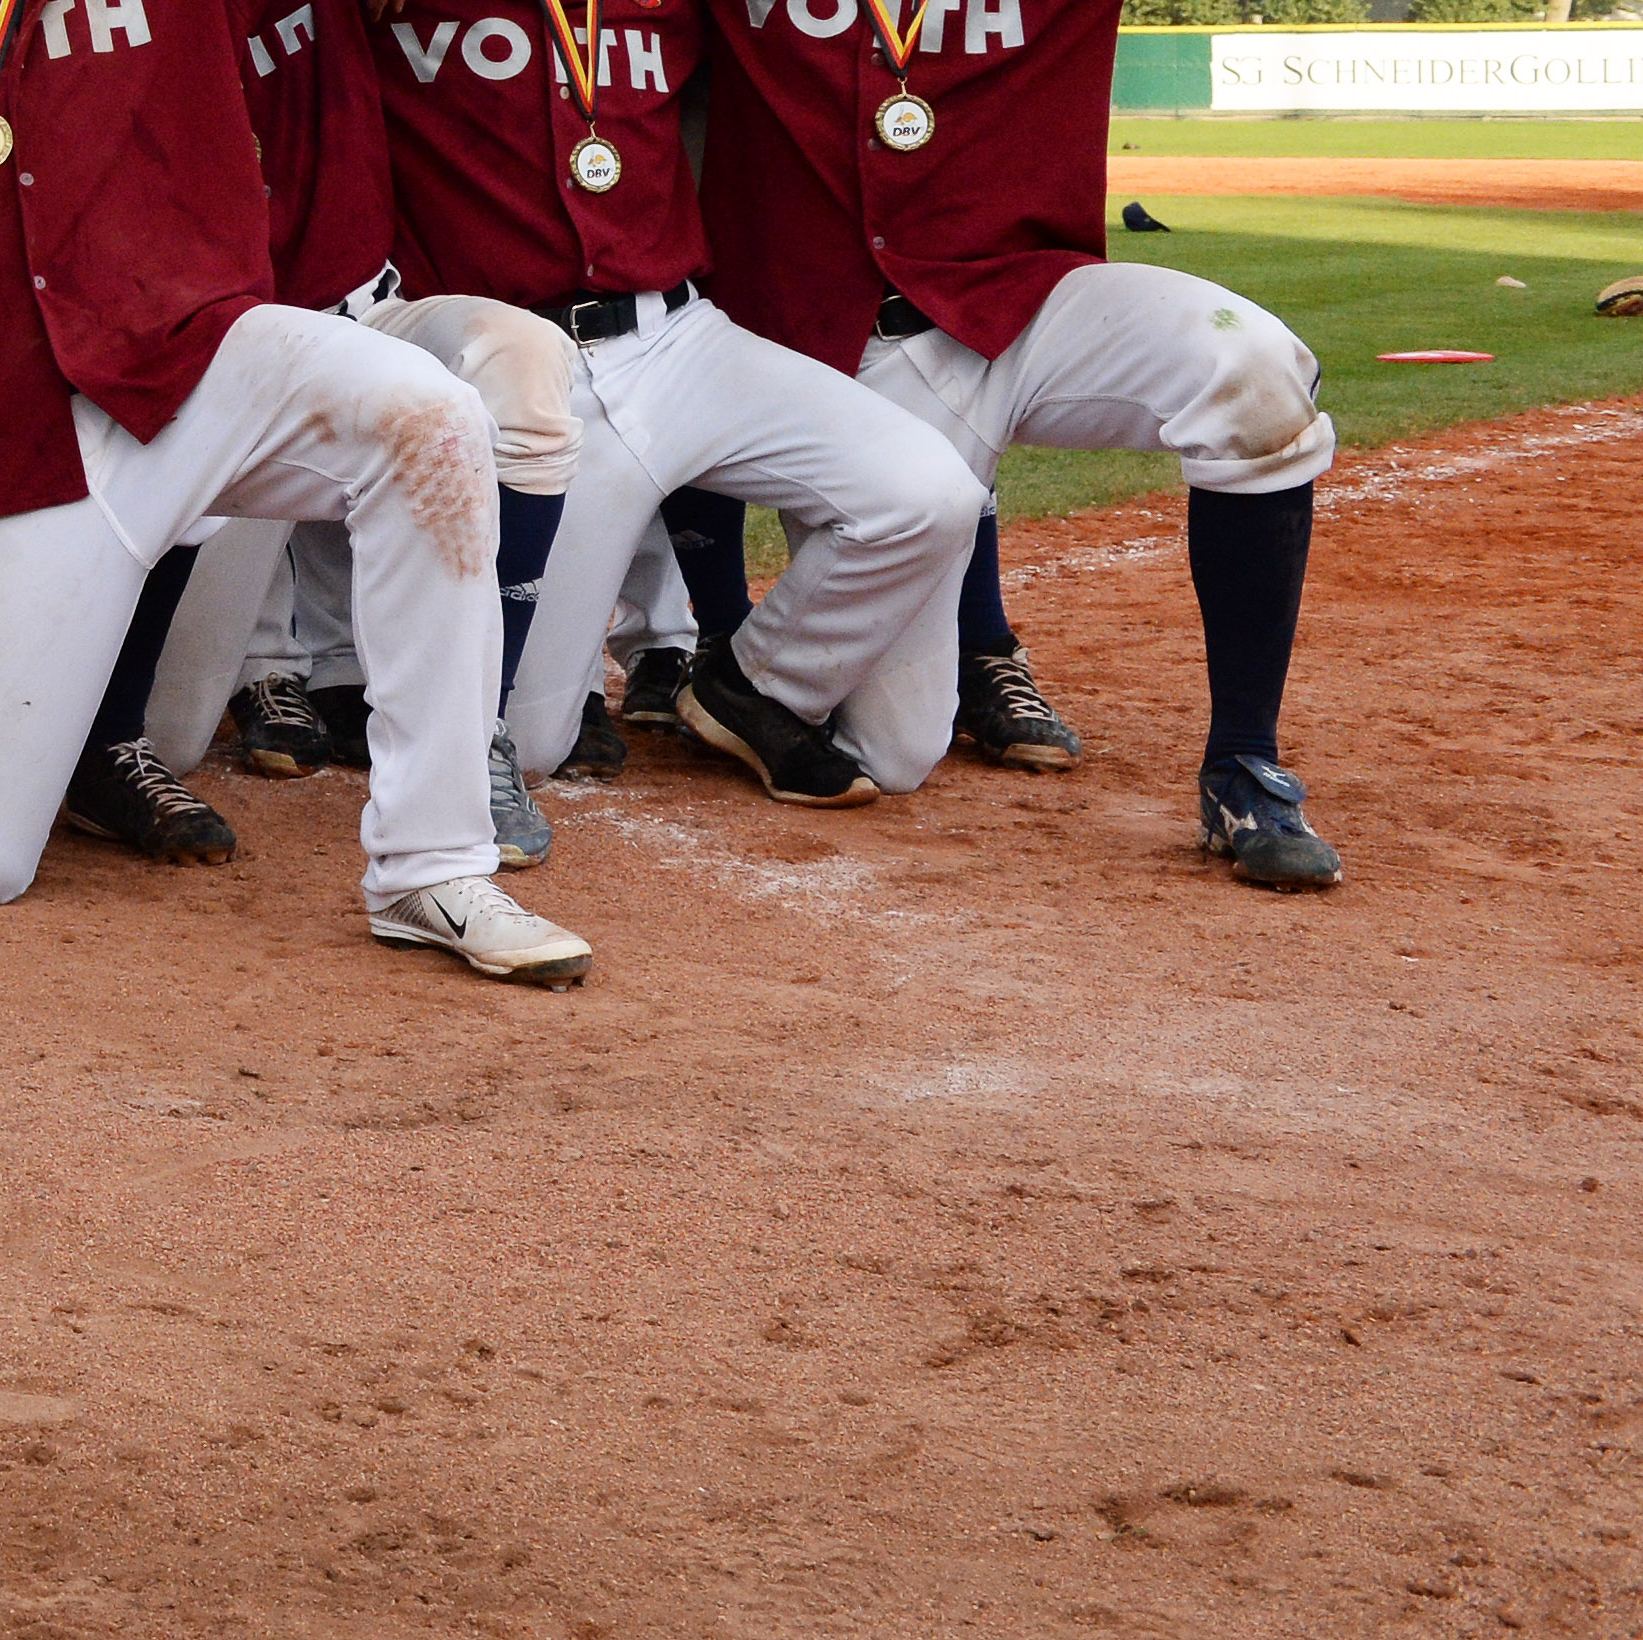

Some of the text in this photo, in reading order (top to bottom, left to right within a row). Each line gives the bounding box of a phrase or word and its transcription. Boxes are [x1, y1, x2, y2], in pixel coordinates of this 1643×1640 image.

[1221, 53, 1643, 87] SG SCHNEIDERGOLLI
[893, 126, 921, 138] DBV
[587, 168, 610, 180] DBV
